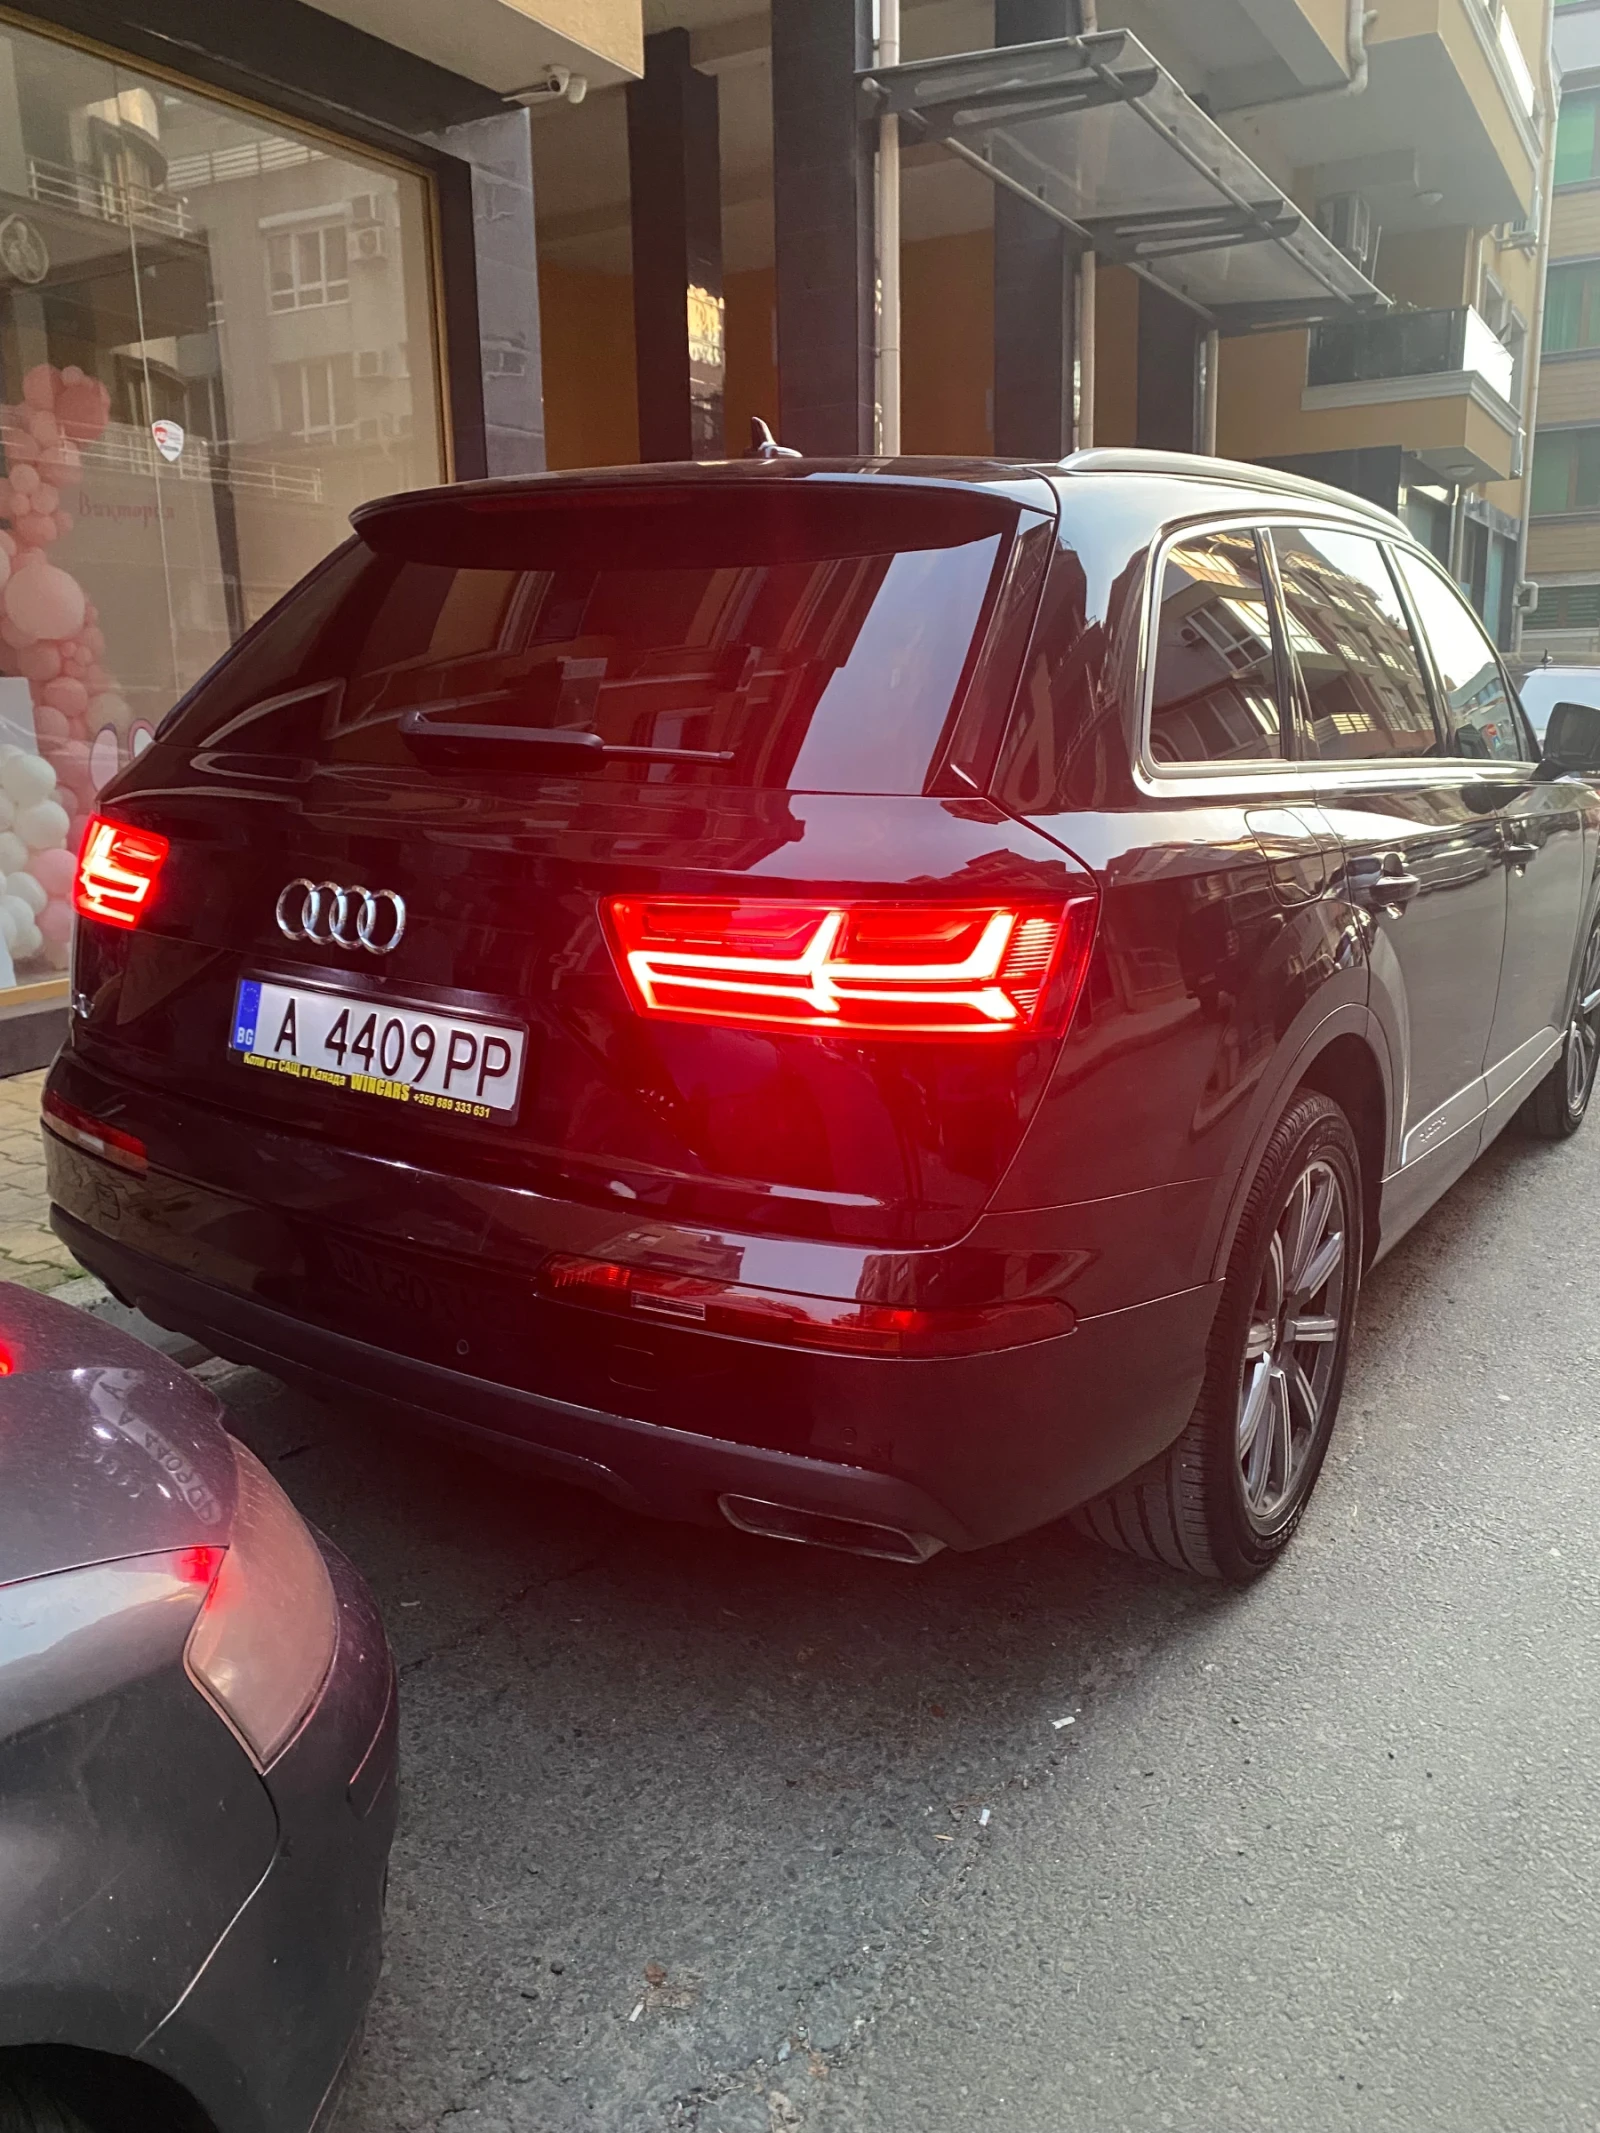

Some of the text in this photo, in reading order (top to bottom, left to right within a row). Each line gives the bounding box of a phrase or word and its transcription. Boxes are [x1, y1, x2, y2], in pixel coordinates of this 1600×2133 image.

[236, 1027, 254, 1046] BG
[274, 998, 297, 1057] A
[266, 1059, 278, 1069] от
[278, 1060, 300, 1078] САЩ
[302, 1066, 310, 1078] и
[310, 1066, 346, 1086] Канада
[351, 1073, 411, 1102] WINCARS
